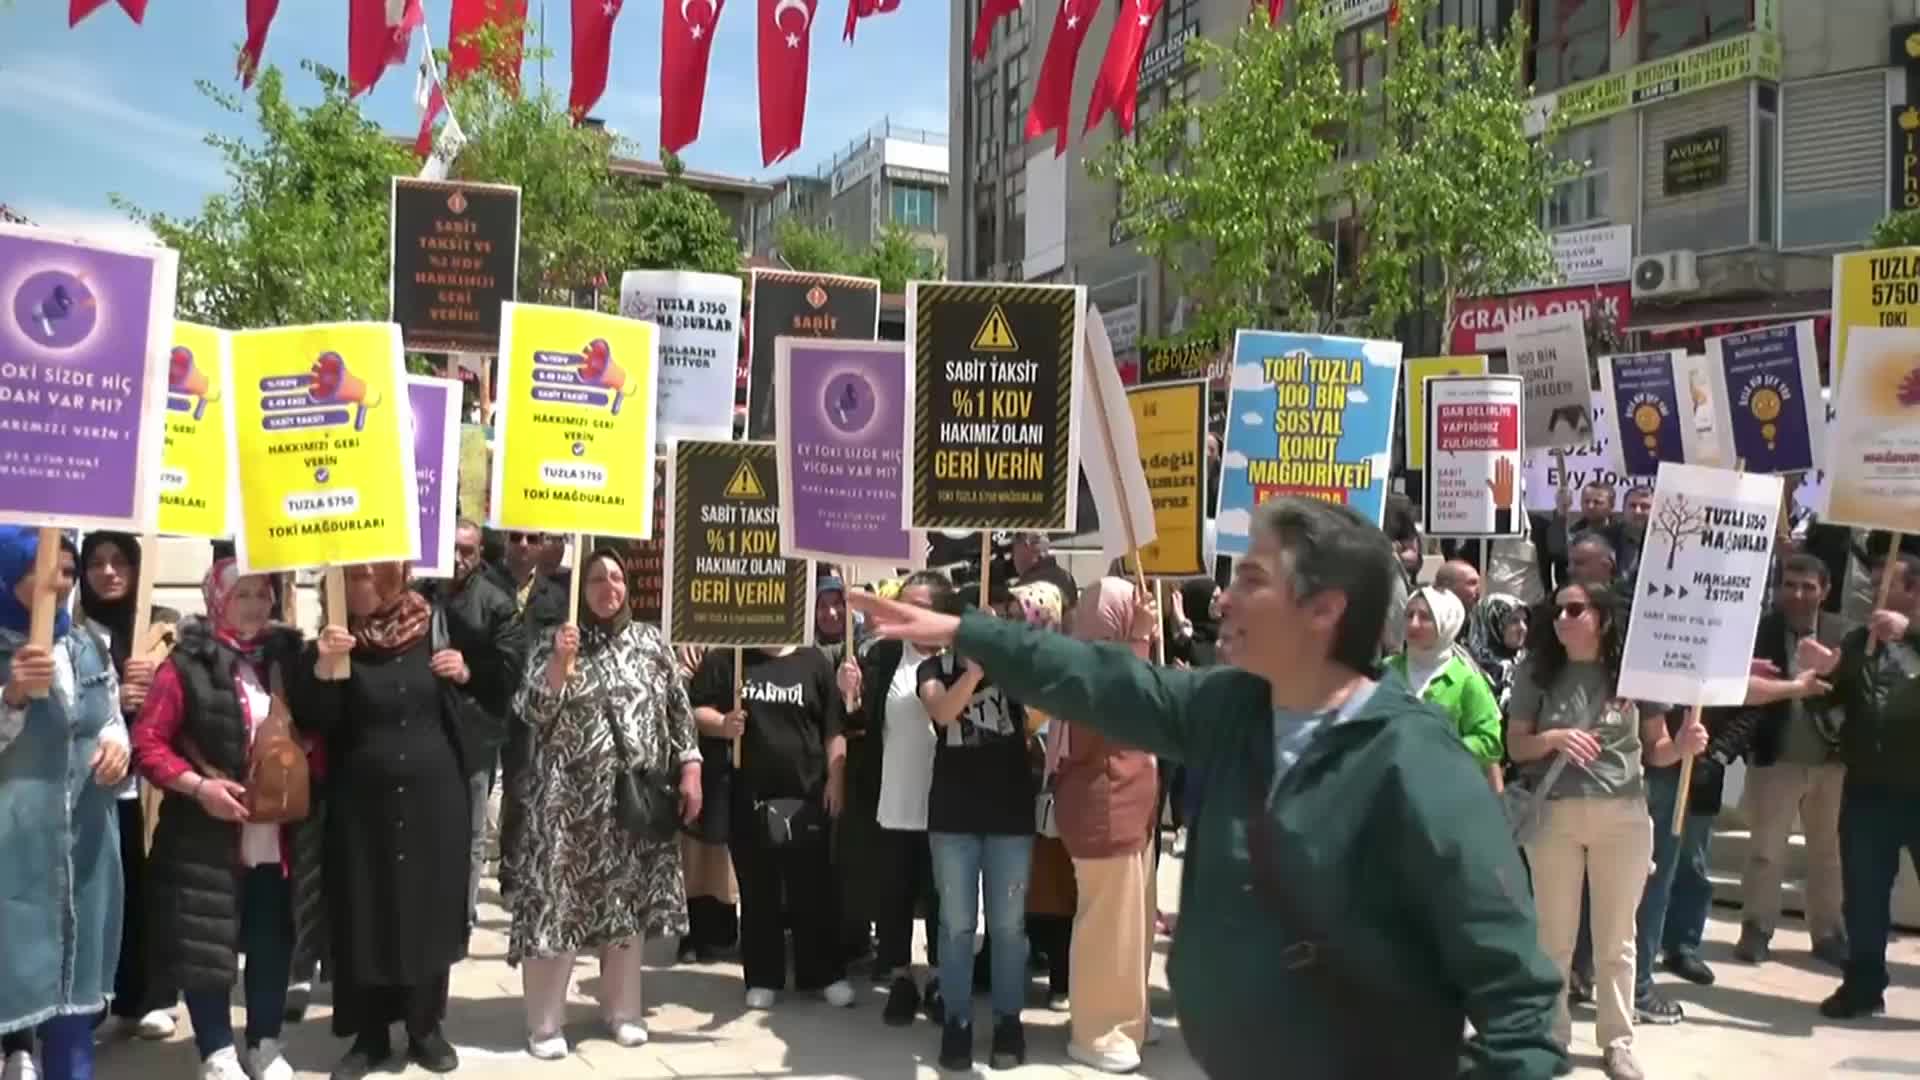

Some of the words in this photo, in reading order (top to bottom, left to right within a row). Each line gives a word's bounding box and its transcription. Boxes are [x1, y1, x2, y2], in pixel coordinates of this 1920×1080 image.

[1669, 138, 1720, 160] AVUKAT
[1869, 256, 1920, 281] TUZLA
[656, 297, 695, 313] TUZLA
[1872, 283, 1919, 306] 5750
[1460, 304, 1538, 330] GRAND
[1879, 310, 1907, 328] TOKİ
[2, 362, 37, 380] OKİ
[44, 365, 95, 387] SİZDE
[102, 373, 133, 396] HİÇ
[945, 358, 987, 383] SABİT
[990, 358, 1039, 383] TAKSİT
[1264, 354, 1303, 384] TOKİ
[1310, 359, 1362, 385] TUZLA
[0, 387, 40, 404] DAN
[48, 391, 84, 409] VAR
[91, 397, 123, 413] MI?
[991, 389, 1033, 418] KDV
[1277, 385, 1310, 408] 100
[1315, 381, 1345, 409] BİN
[533, 413, 588, 427] HAKKIMIZI
[593, 418, 614, 430] GERİ
[1275, 410, 1343, 436] SOSYAL
[564, 431, 594, 443] VERİN
[940, 421, 1001, 444] HAKIMIZ
[1002, 423, 1044, 445] OLANI
[268, 441, 329, 455] HAKKIMIZI
[334, 438, 359, 449] GERİ
[797, 443, 811, 456] EY
[1279, 436, 1337, 461] KONUT
[303, 456, 337, 467] VERİN
[802, 461, 843, 476] VİCDAN
[847, 464, 873, 477] VAR
[935, 446, 979, 480] GERİ
[985, 447, 1044, 481] VERİN
[1150, 451, 1194, 473] değil
[1248, 457, 1372, 488] MAĞDURİYETİ
[544, 466, 577, 480] TUZLA
[580, 470, 603, 482] 5750
[159, 493, 206, 509] DURLARI
[288, 498, 325, 511] TUZLA
[327, 496, 354, 508] 5750
[523, 488, 549, 501] TOKİ
[552, 489, 625, 506] MAĞDURLARI
[701, 503, 737, 524] SABİT
[741, 504, 780, 524] TAKSİT
[1704, 506, 1745, 528] TUZLA
[269, 523, 298, 538] TOKİ
[301, 518, 385, 536] MAĞDURLARI
[740, 529, 777, 555] KDV
[696, 556, 748, 576] HAKIMIZ
[750, 558, 786, 577] OLANI
[691, 577, 730, 604] GERİ
[734, 579, 786, 607] VERİN
[741, 678, 804, 707] STANBUL
